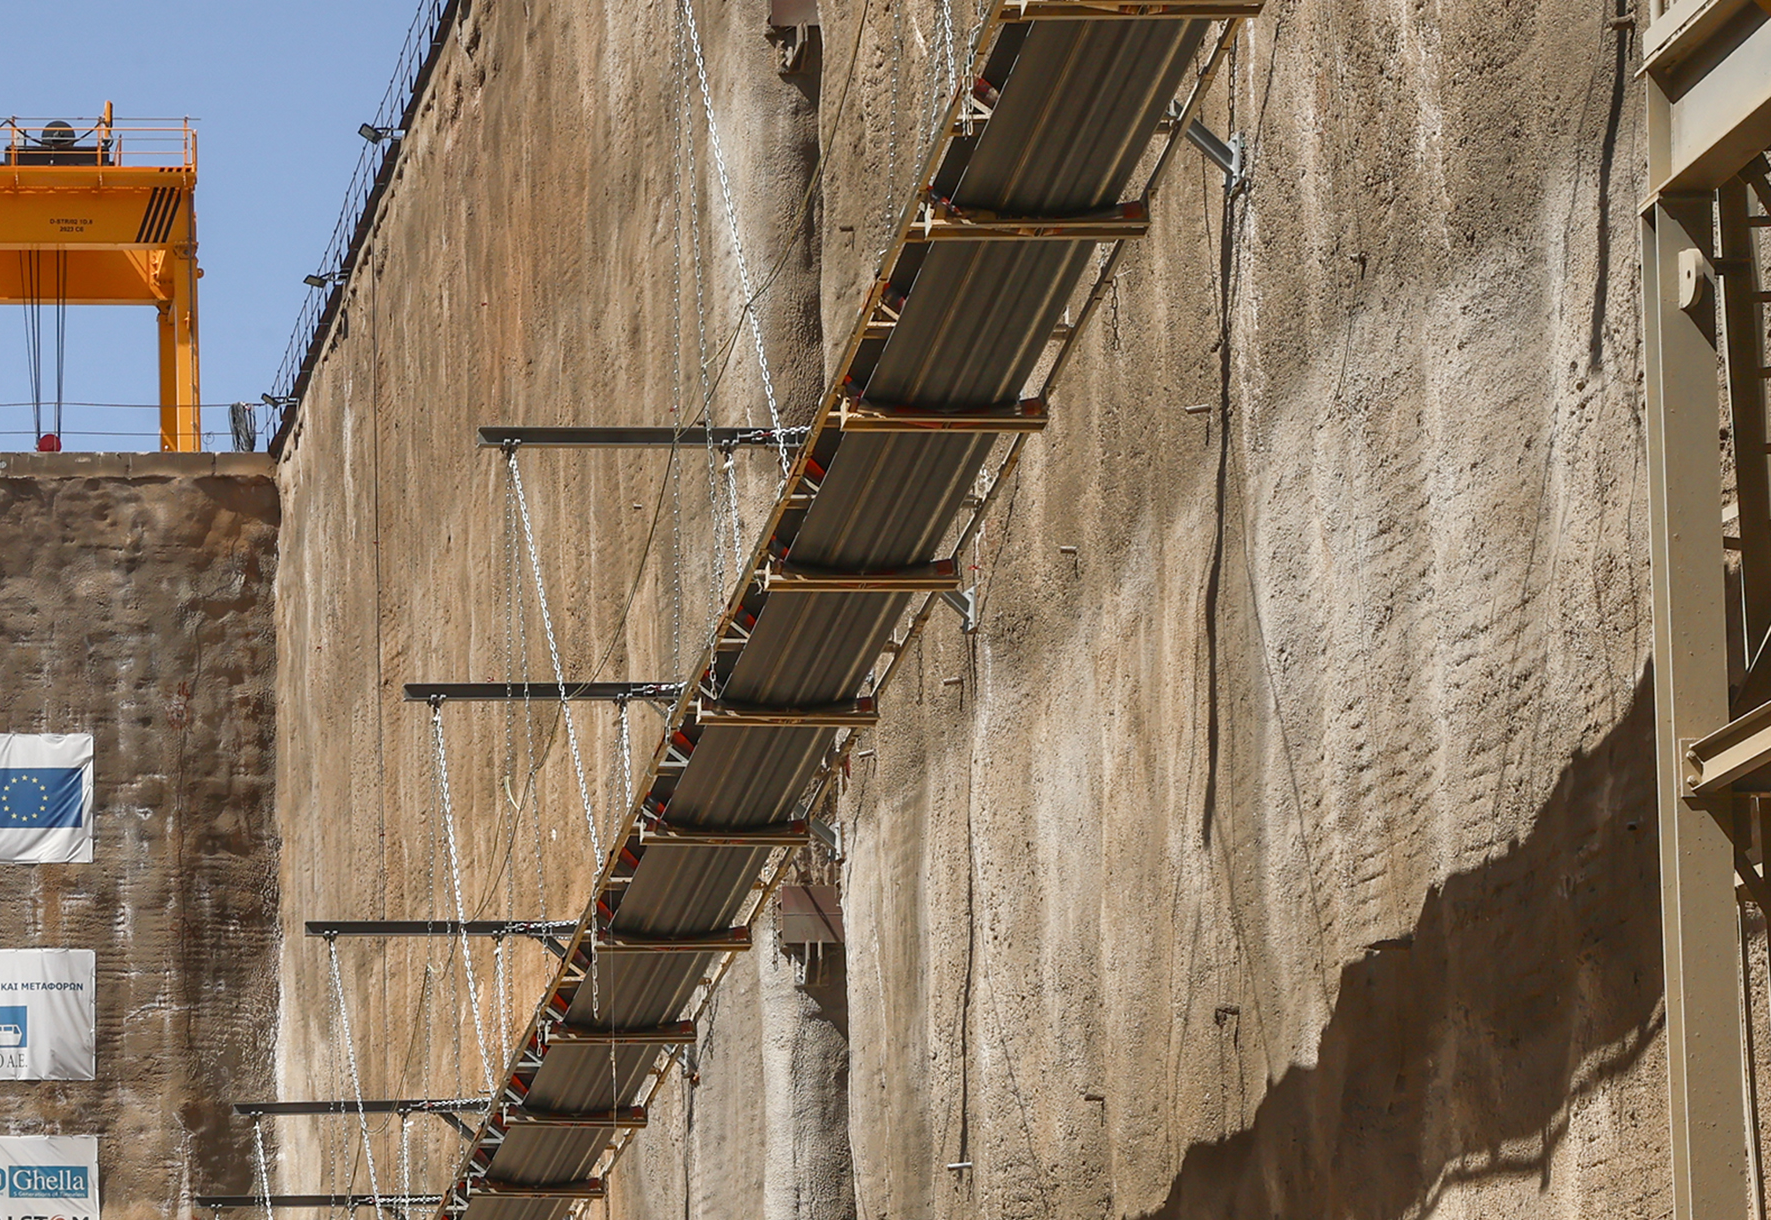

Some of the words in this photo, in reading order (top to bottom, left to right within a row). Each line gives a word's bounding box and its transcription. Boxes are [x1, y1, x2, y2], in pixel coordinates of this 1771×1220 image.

[1, 982, 19, 991] ΚΑΙ
[22, 982, 84, 992] ΜΕΤΑΦΟΡΩΝ
[7, 1054, 28, 1069] Α.Ε.
[12, 1169, 85, 1191] Ghella
